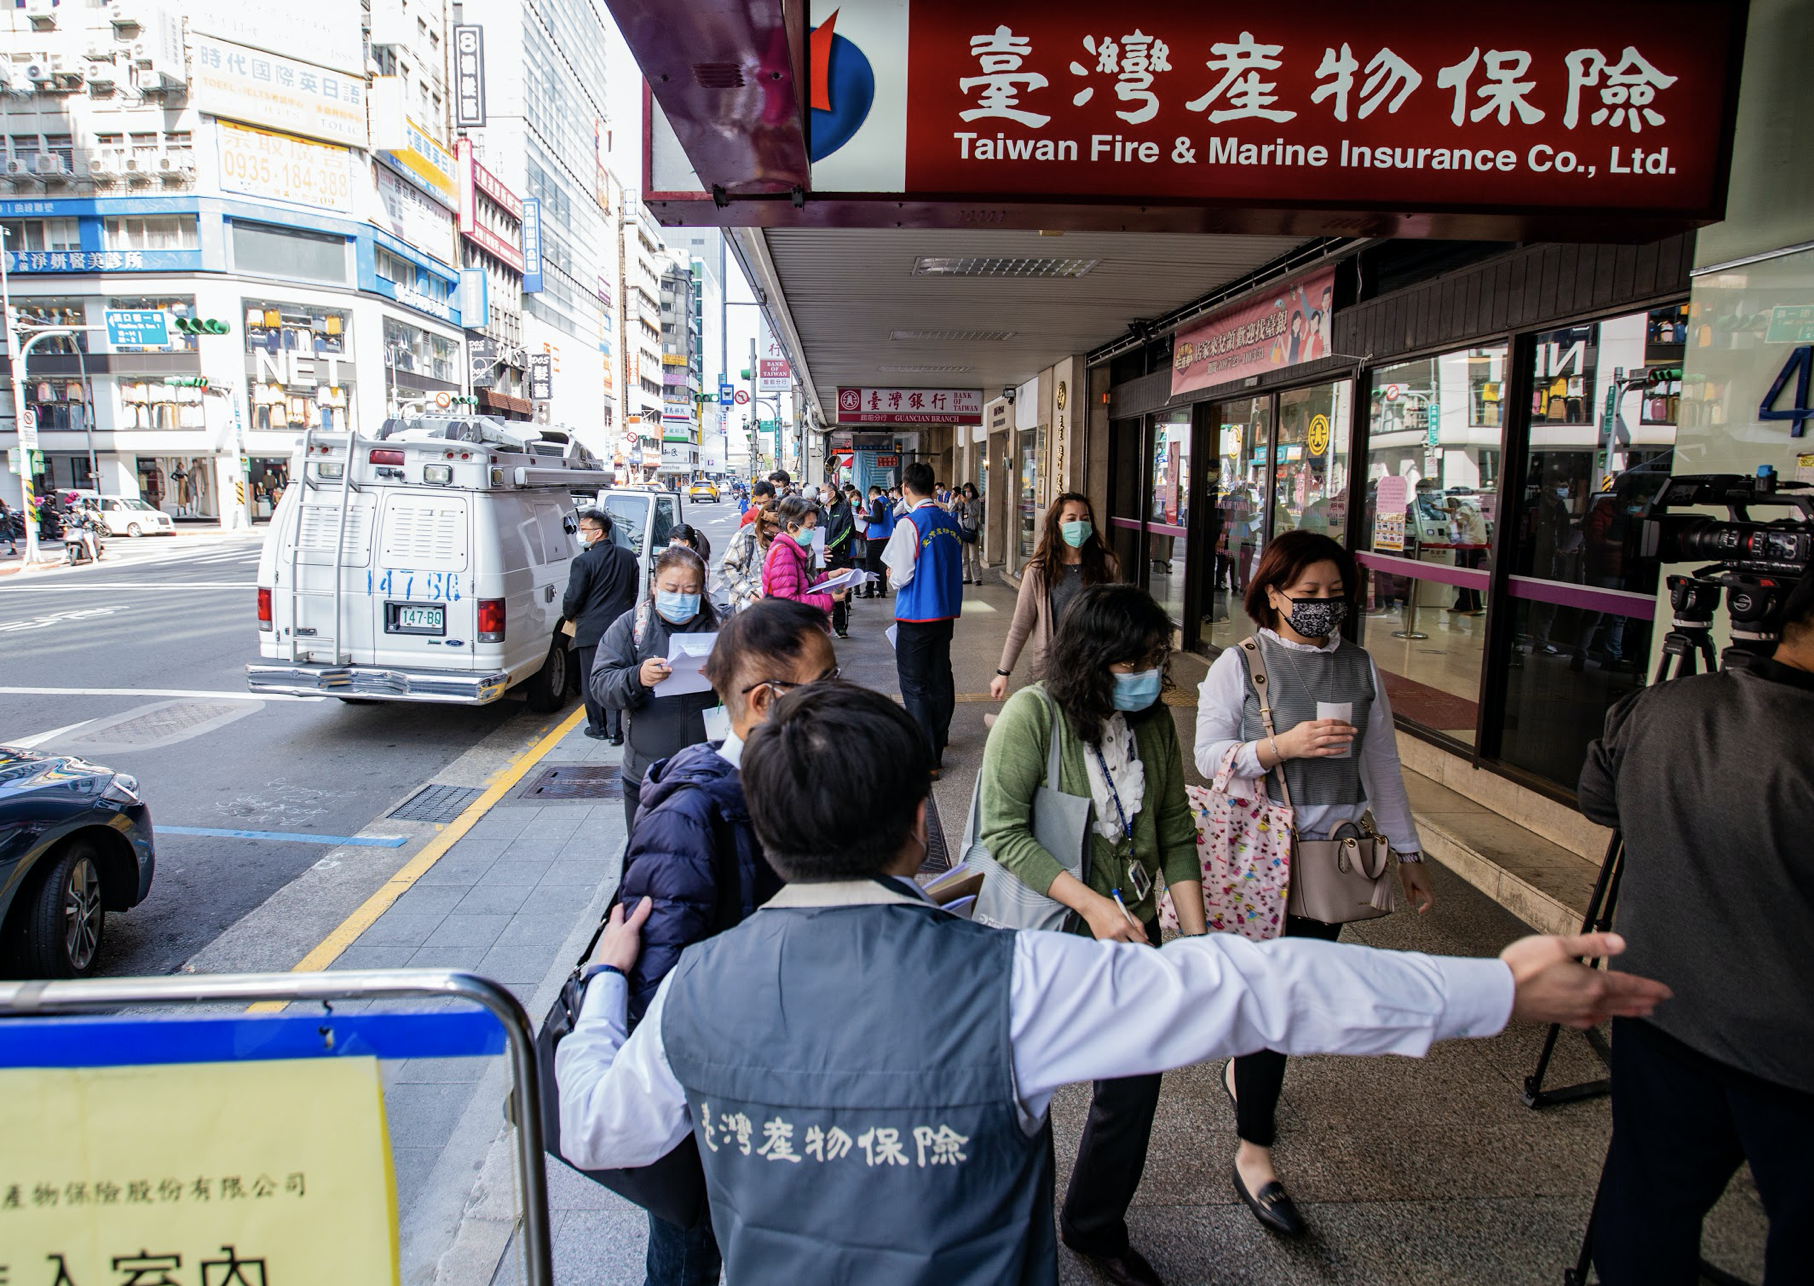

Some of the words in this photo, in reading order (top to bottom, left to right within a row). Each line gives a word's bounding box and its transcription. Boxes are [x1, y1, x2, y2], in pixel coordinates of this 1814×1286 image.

[201, 45, 360, 105] 時代國際英日語
[959, 25, 1679, 133] 臺灣產物保險
[954, 132, 1077, 160] Taiwan
[1091, 134, 1160, 162] Fire
[1172, 136, 1196, 163] &
[1209, 137, 1329, 166] Marine
[1341, 140, 1517, 171] Insurance
[1527, 144, 1596, 178] Co.,
[1609, 146, 1676, 174] Ltd.
[255, 346, 353, 388] NET
[532, 356, 550, 364] DOS
[868, 391, 947, 411] 臺灣銀行
[895, 414, 930, 422] GUANCIAN
[931, 415, 959, 423] BRANCH
[403, 610, 441, 625] 147-BQ
